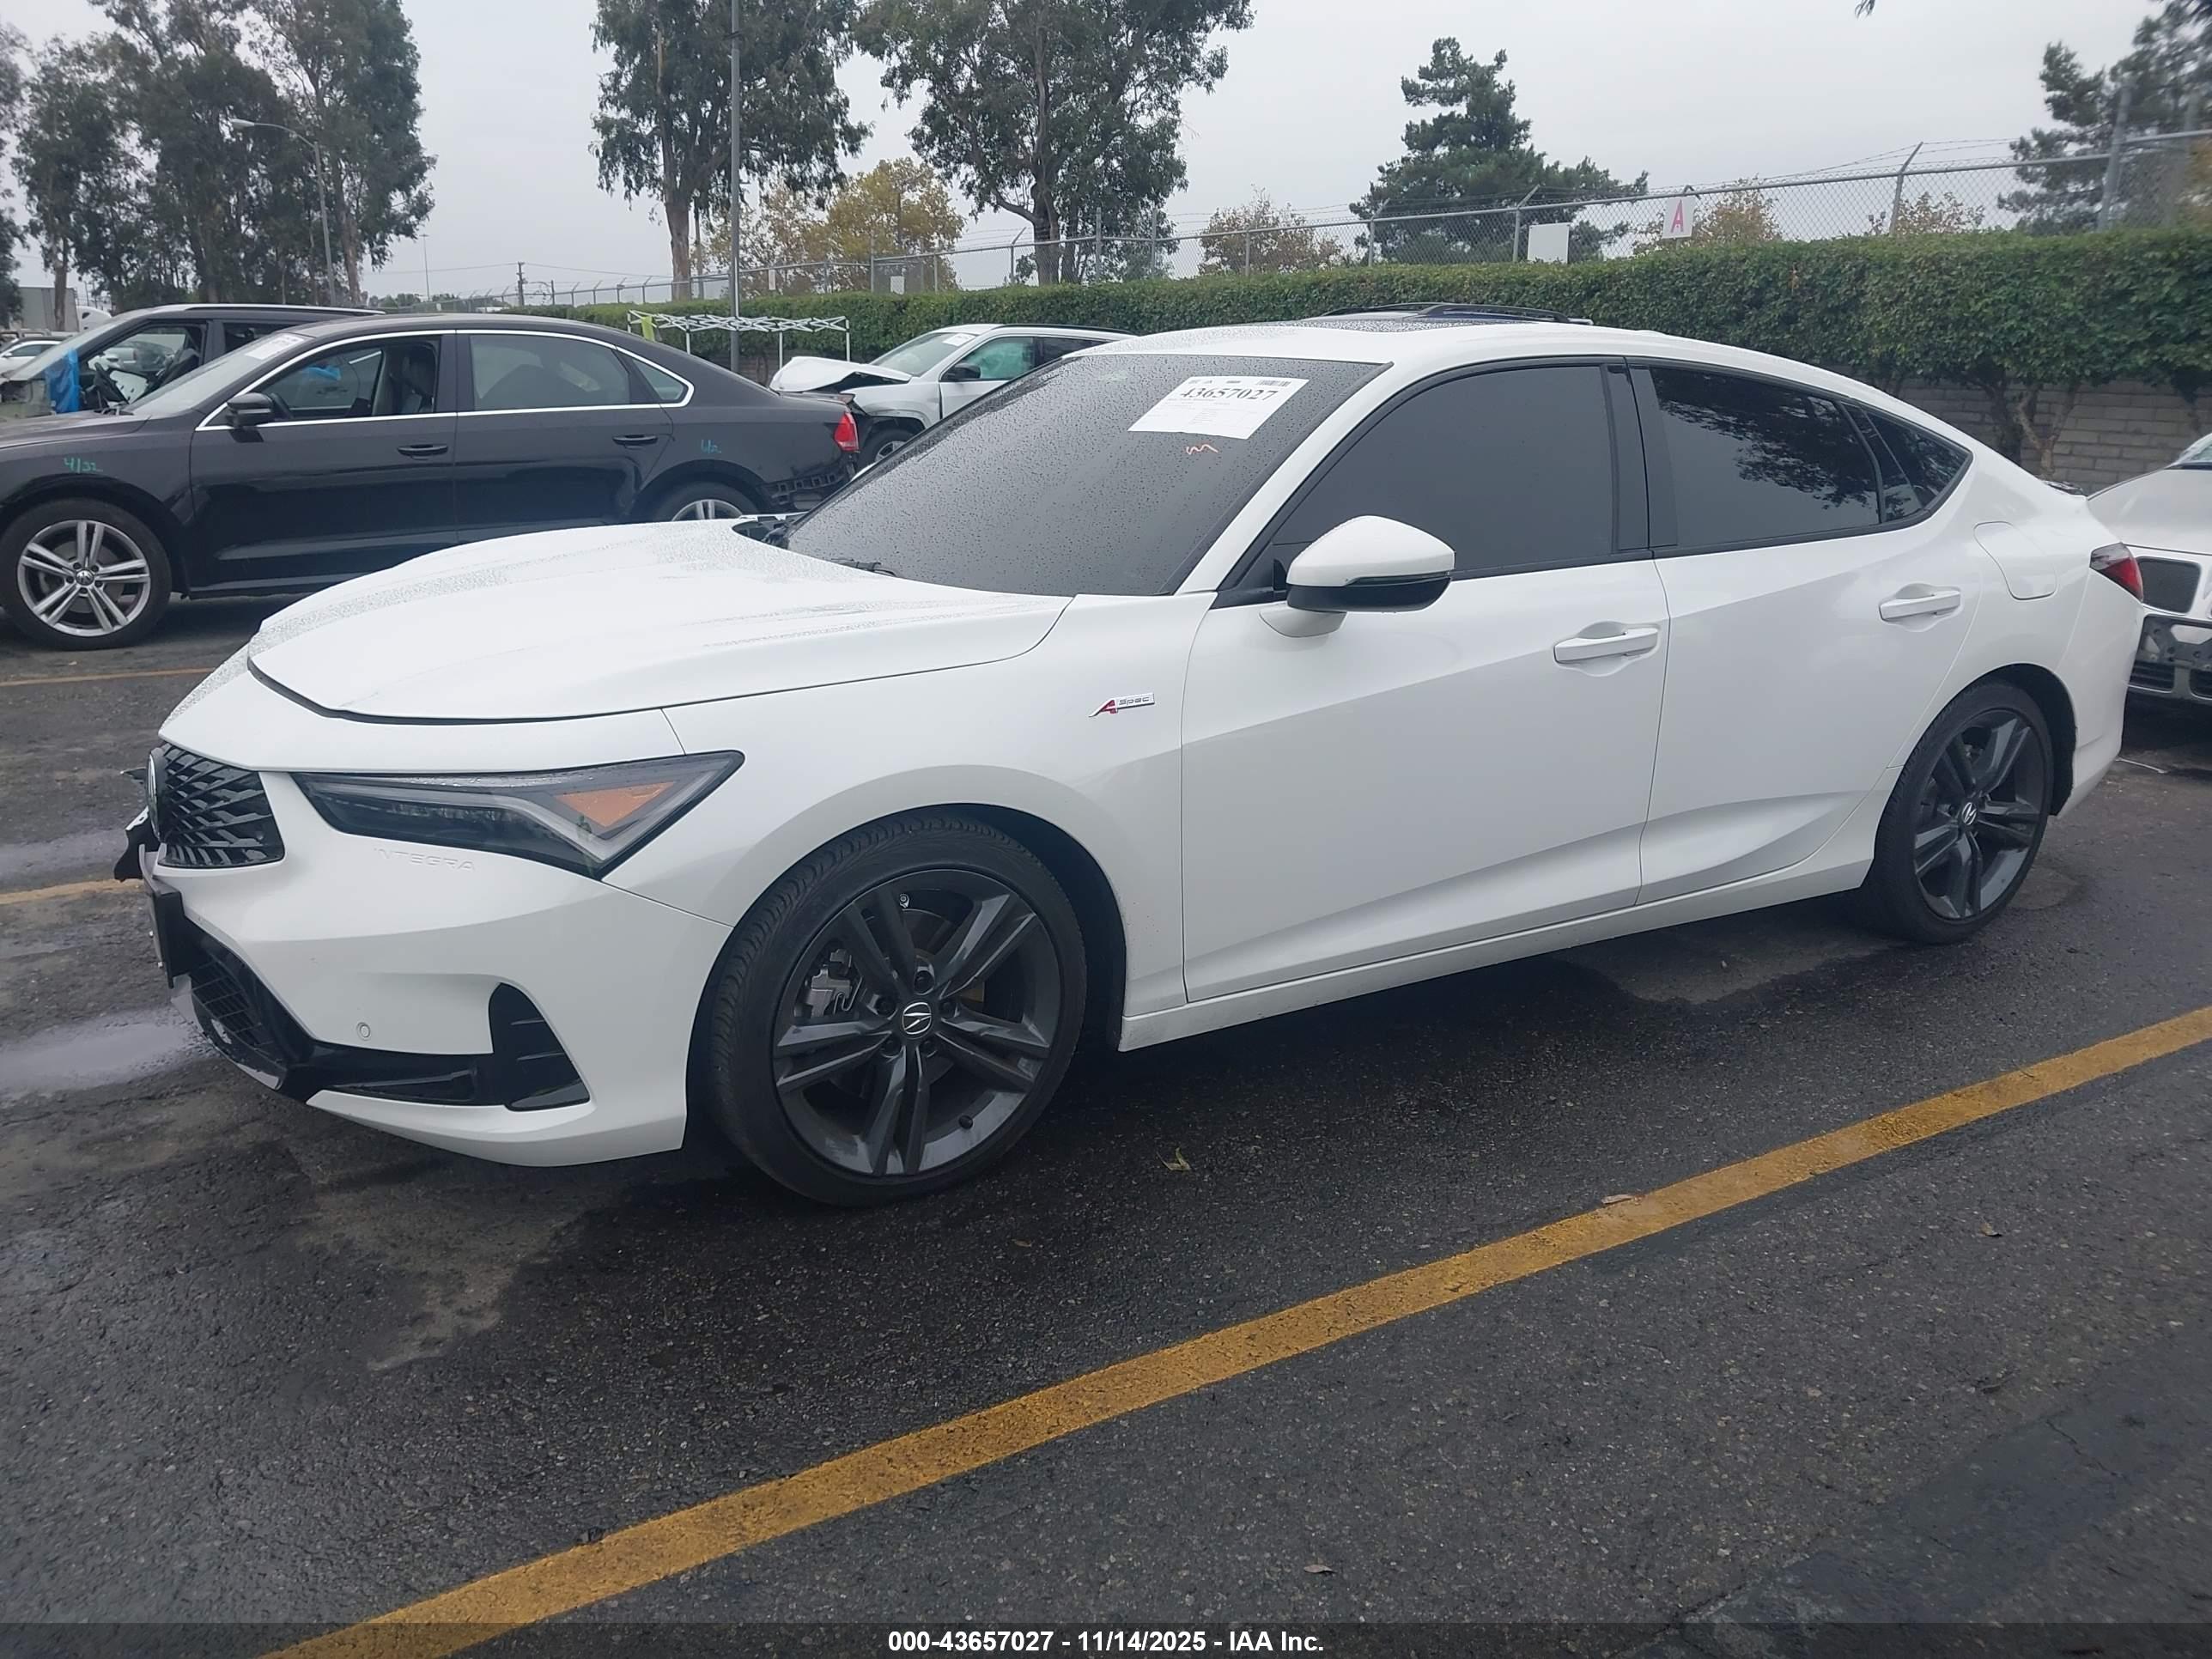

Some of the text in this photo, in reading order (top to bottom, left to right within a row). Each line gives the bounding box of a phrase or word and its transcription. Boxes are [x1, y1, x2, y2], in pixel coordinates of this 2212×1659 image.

[1670, 198, 1684, 233] A
[1180, 387, 1279, 401] 43657027
[373, 847, 476, 871] NTEGRA
